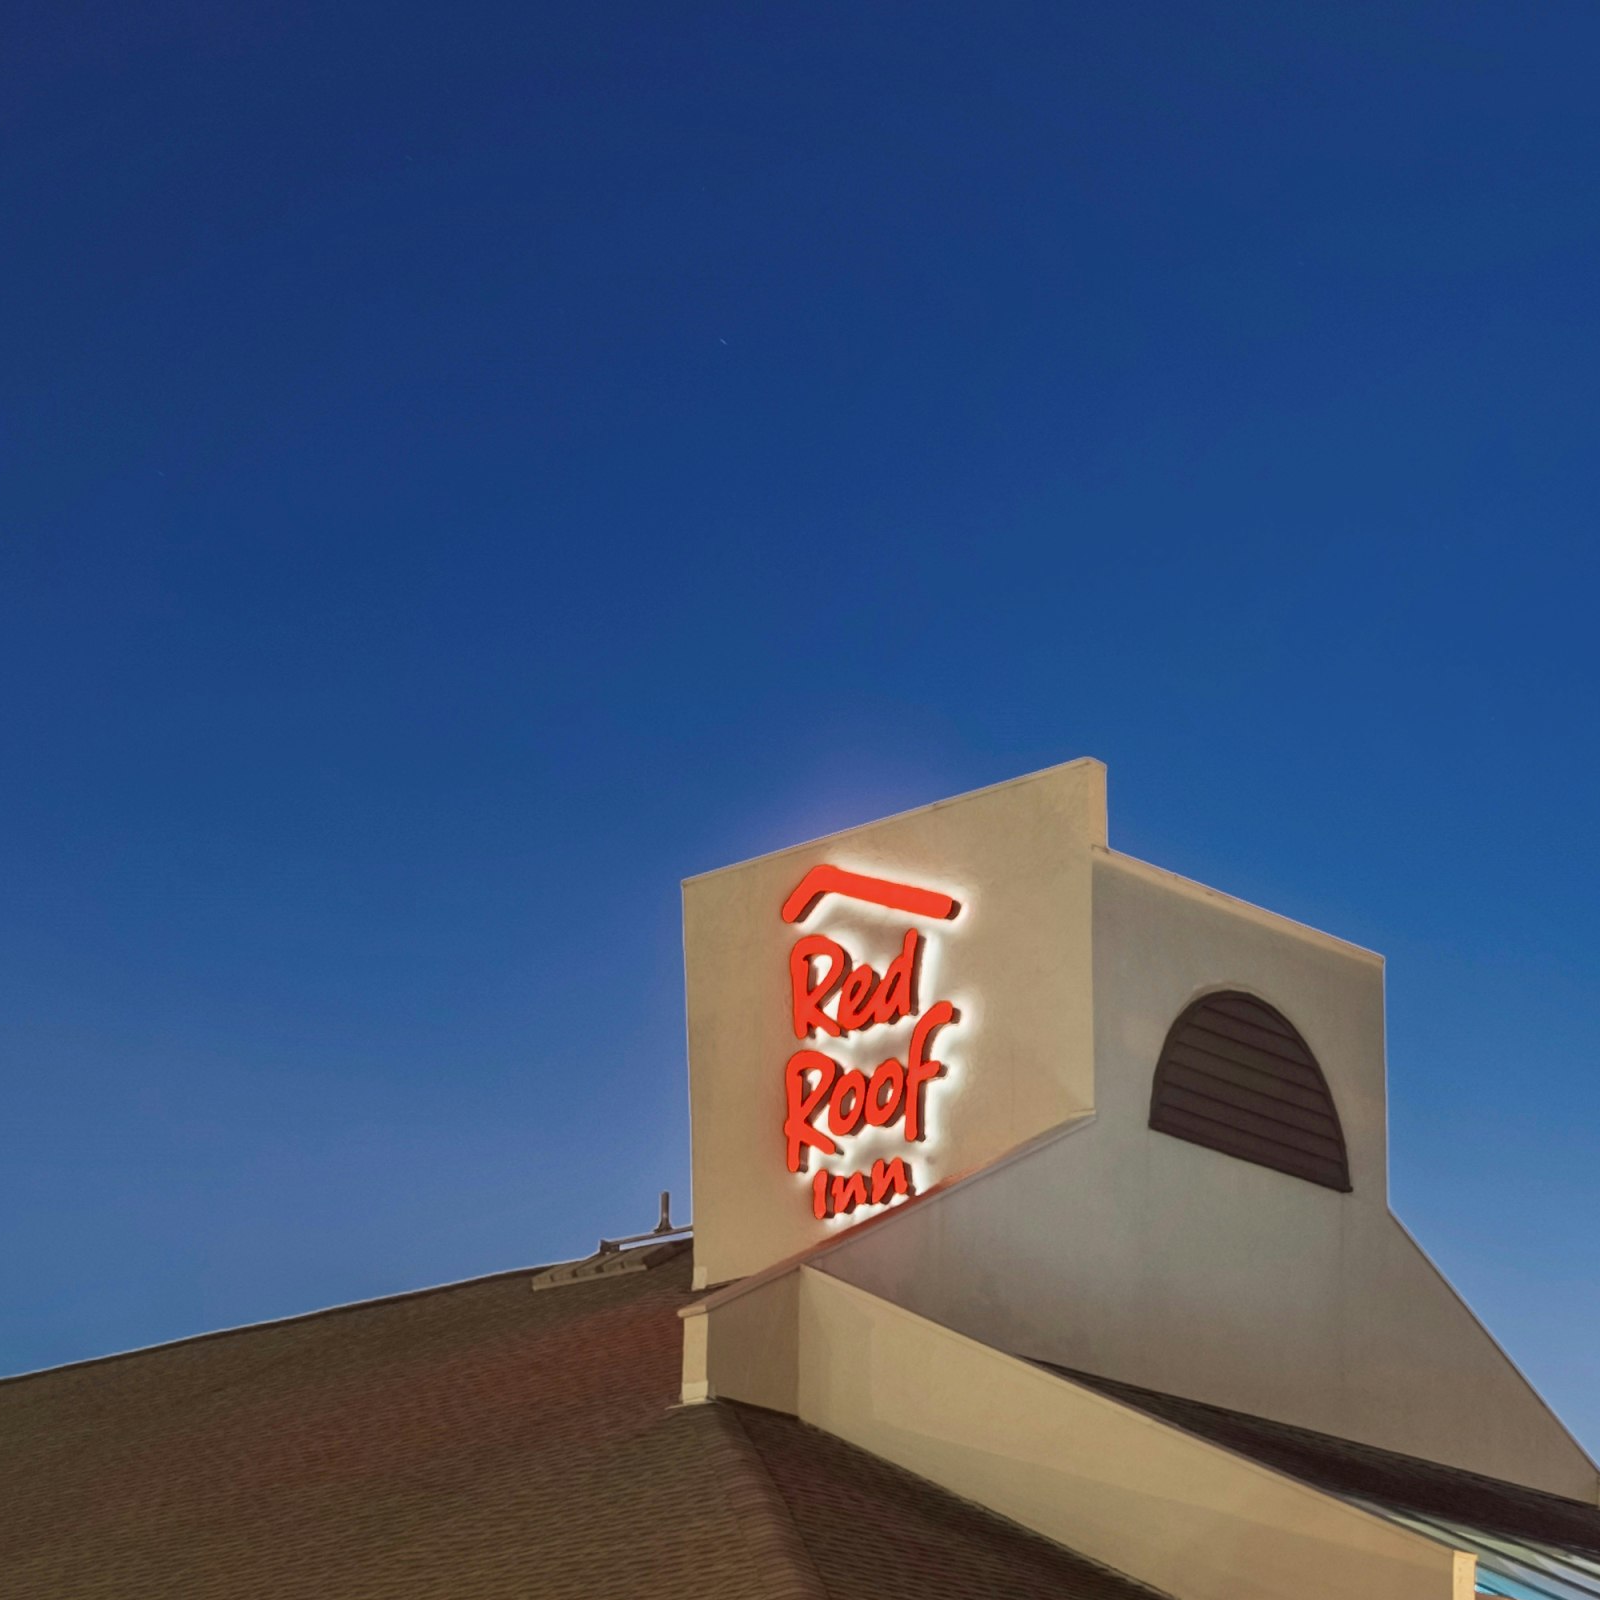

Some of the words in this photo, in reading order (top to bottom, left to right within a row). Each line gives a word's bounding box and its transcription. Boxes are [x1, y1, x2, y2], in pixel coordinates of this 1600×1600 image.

[789, 927, 923, 1039] Red
[784, 1000, 957, 1172] Roof
[812, 1157, 912, 1220] Inn
